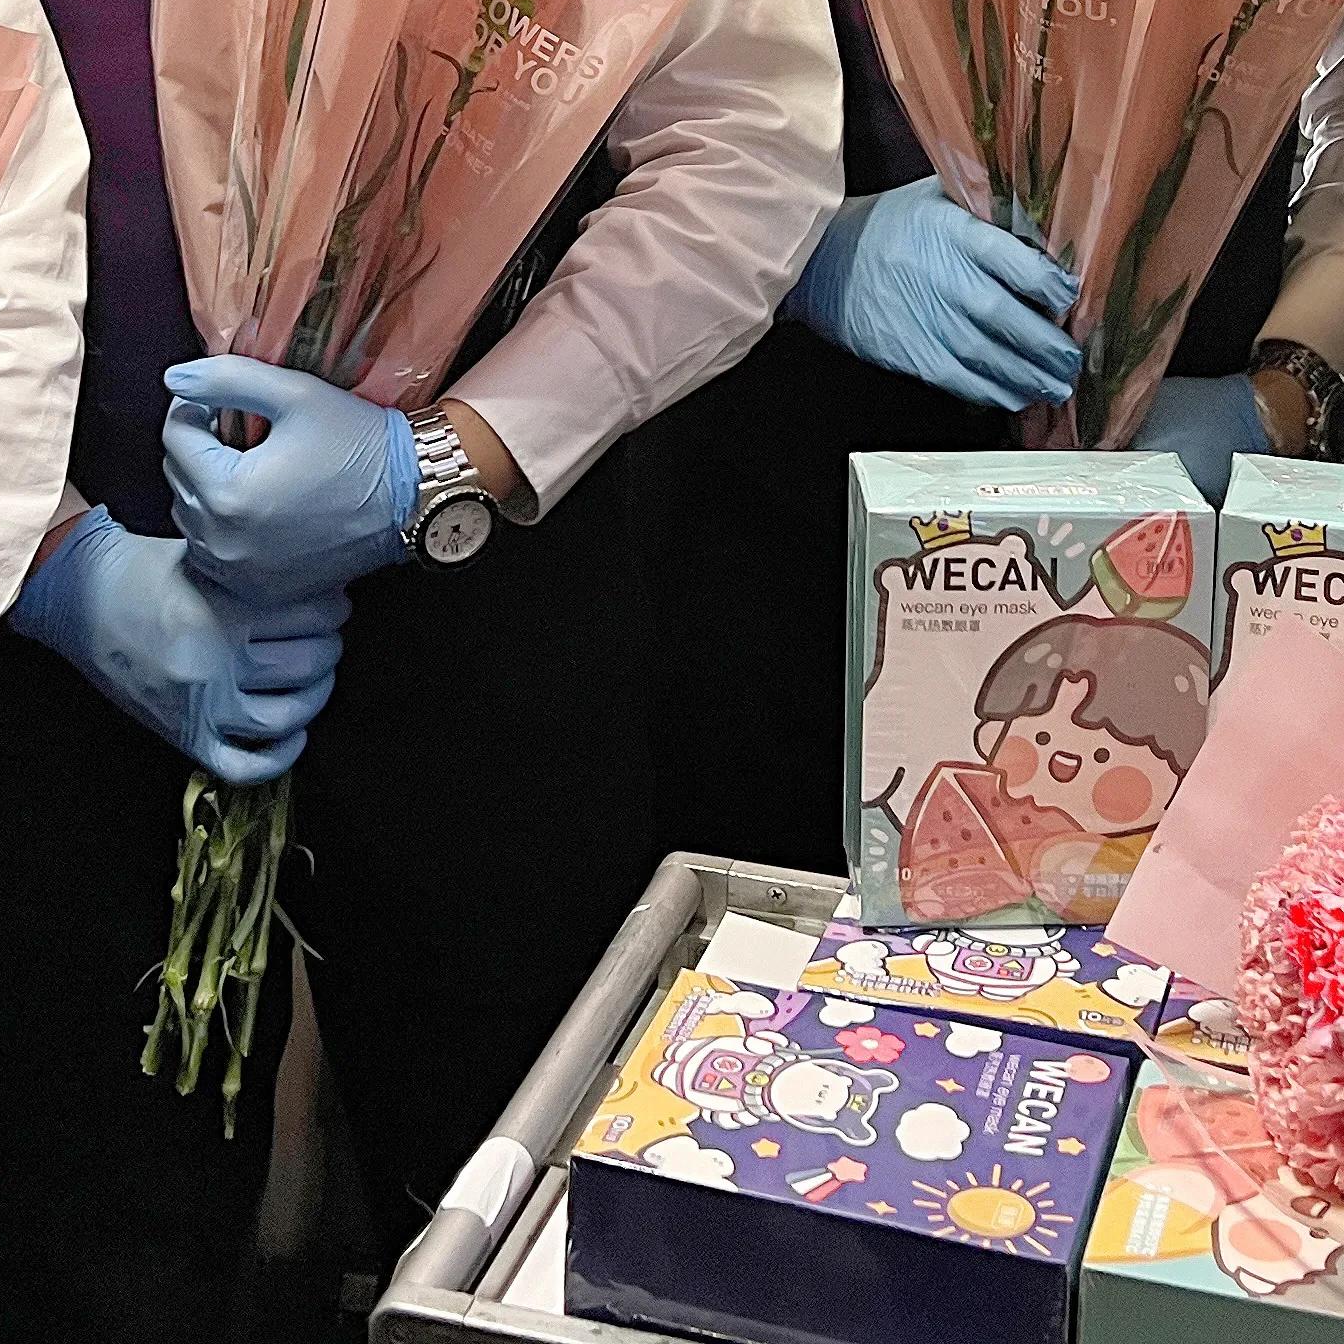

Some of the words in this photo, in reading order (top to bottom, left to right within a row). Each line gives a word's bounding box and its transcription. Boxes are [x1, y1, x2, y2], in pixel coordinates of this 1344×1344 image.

[902, 556, 1058, 592] WECAN
[900, 601, 954, 615] wecan
[959, 602, 988, 617] eye
[993, 600, 1038, 615] mask
[1309, 614, 1339, 632] eye
[1003, 1060, 1073, 1156] WECAN
